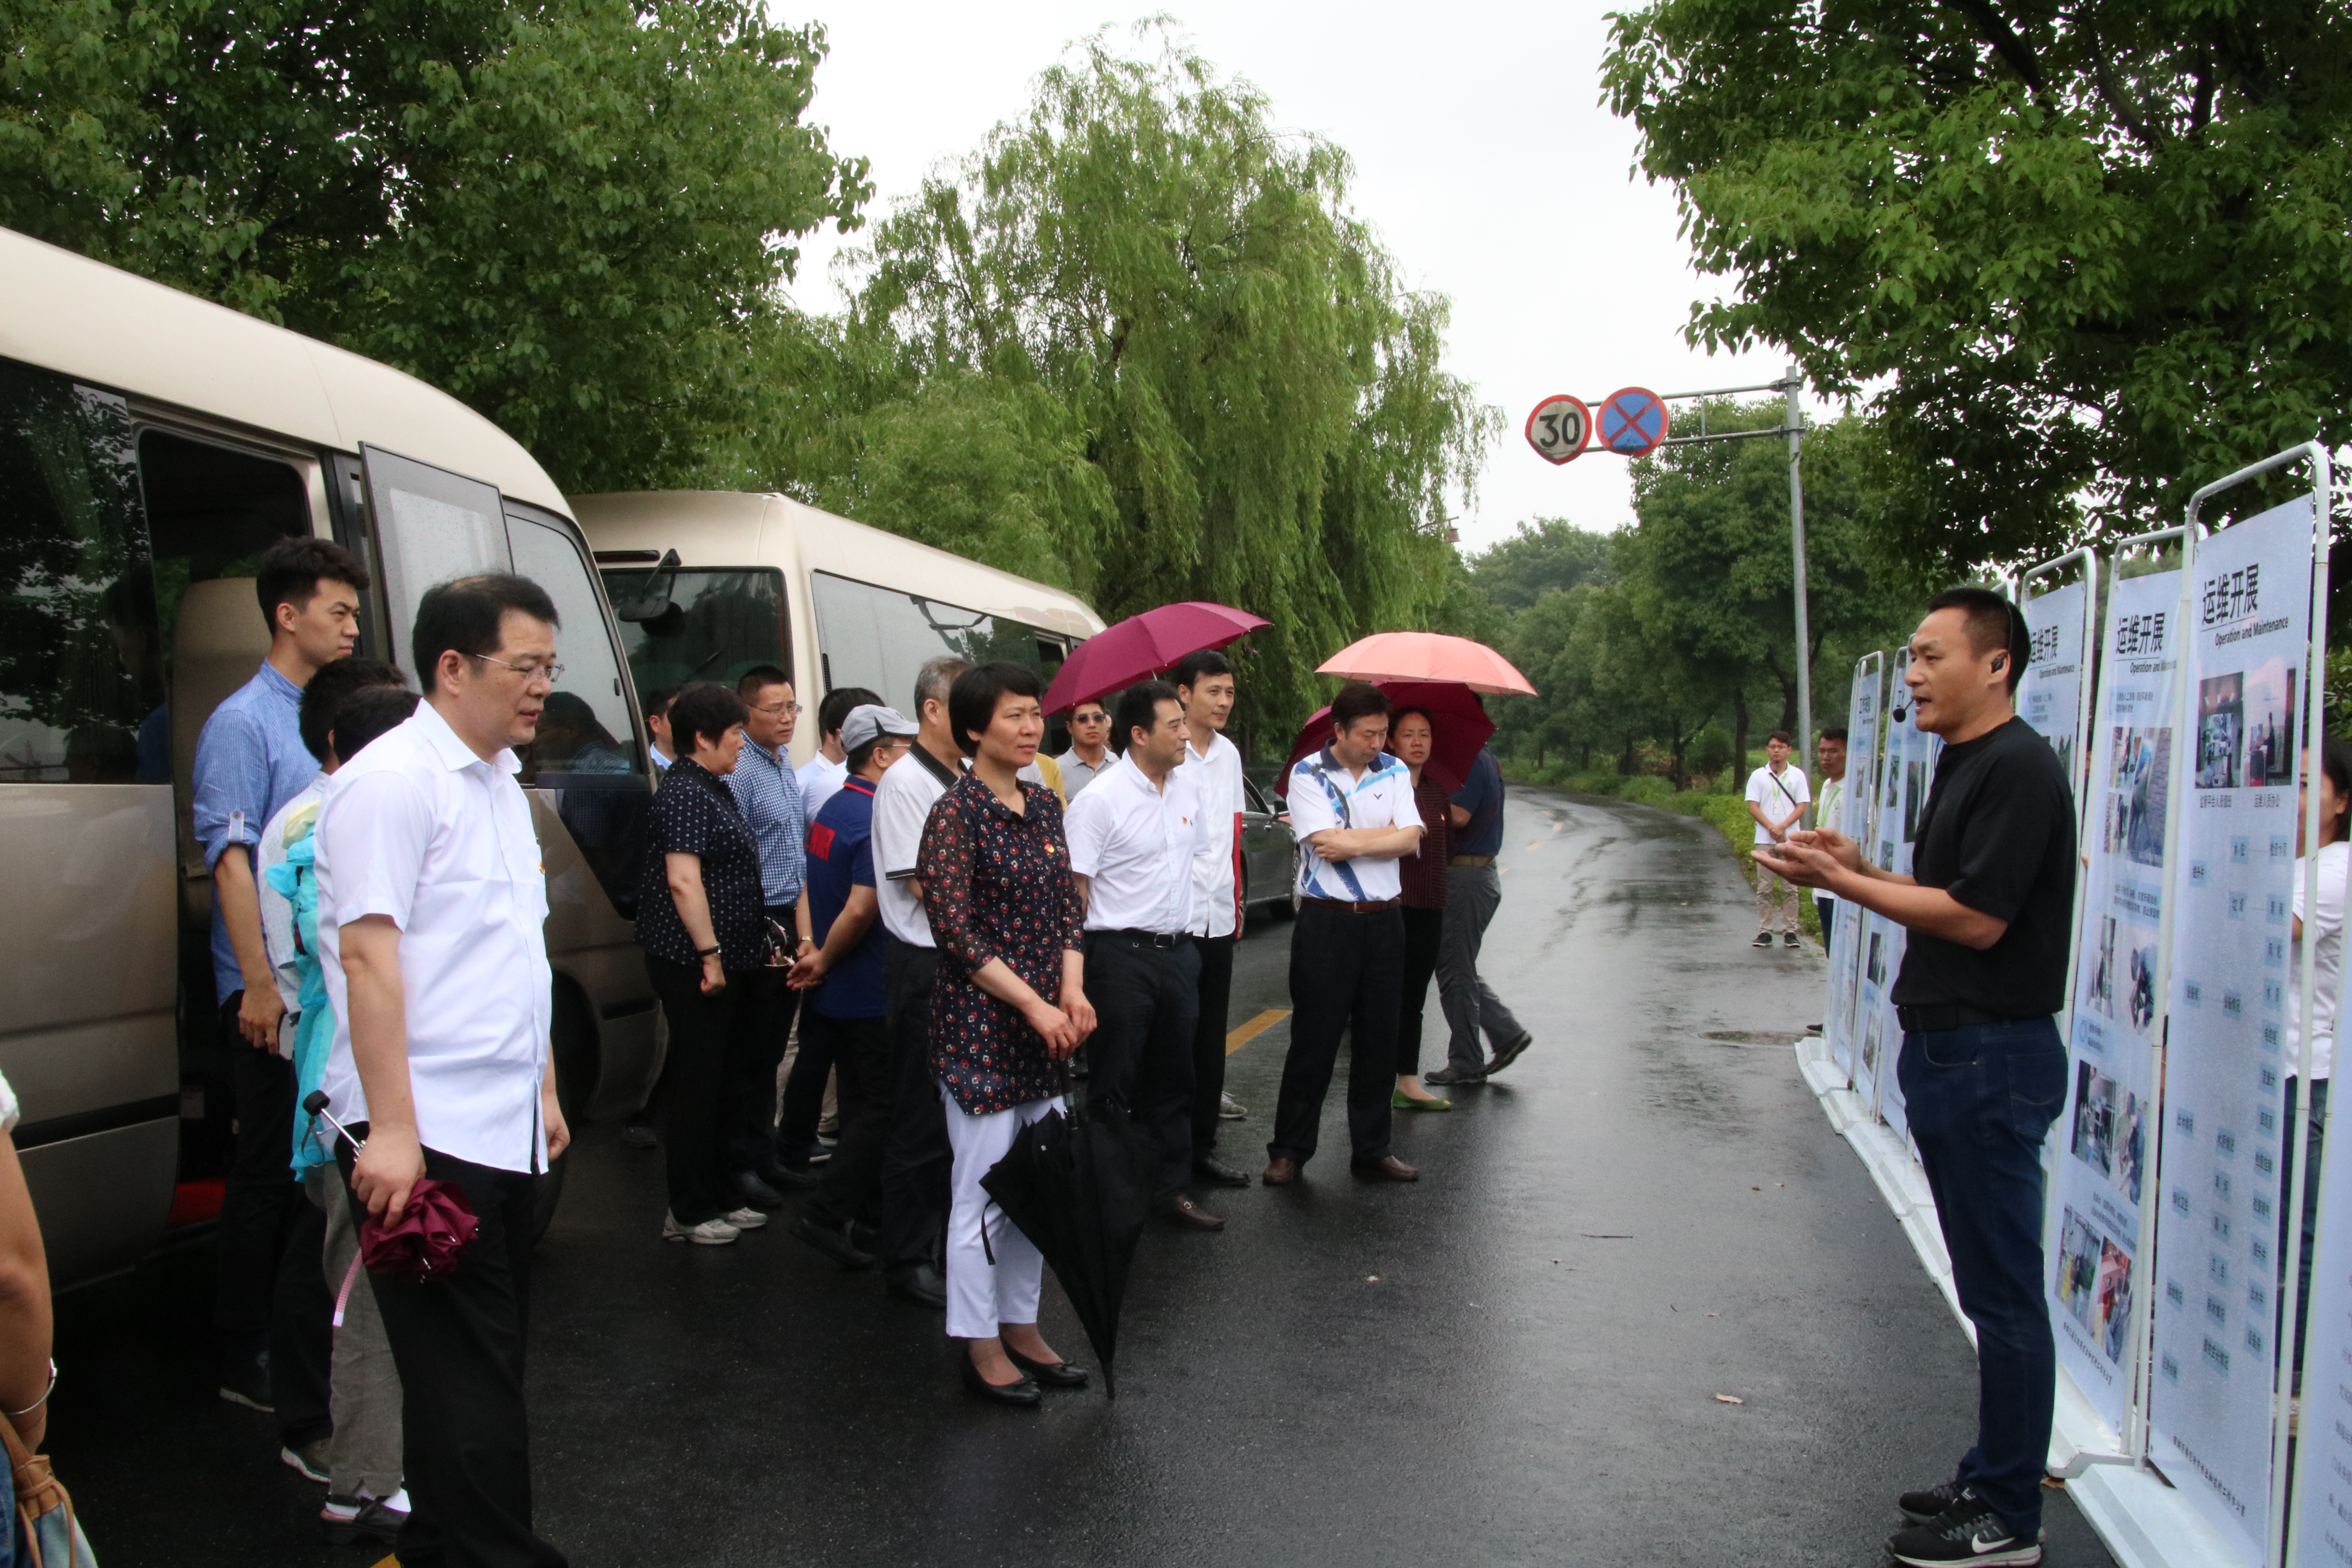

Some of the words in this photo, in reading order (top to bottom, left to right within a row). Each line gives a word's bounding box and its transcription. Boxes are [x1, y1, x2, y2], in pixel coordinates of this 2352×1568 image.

[1539, 412, 1581, 448] 30
[2202, 563, 2258, 625] 运维开展
[2029, 625, 2058, 662] 运维开展
[2116, 613, 2165, 655] 运维开展
[2216, 628, 2240, 649] Operation
[2241, 623, 2252, 639] and
[2254, 617, 2288, 637] Maintenance
[2130, 661, 2152, 675] Operation
